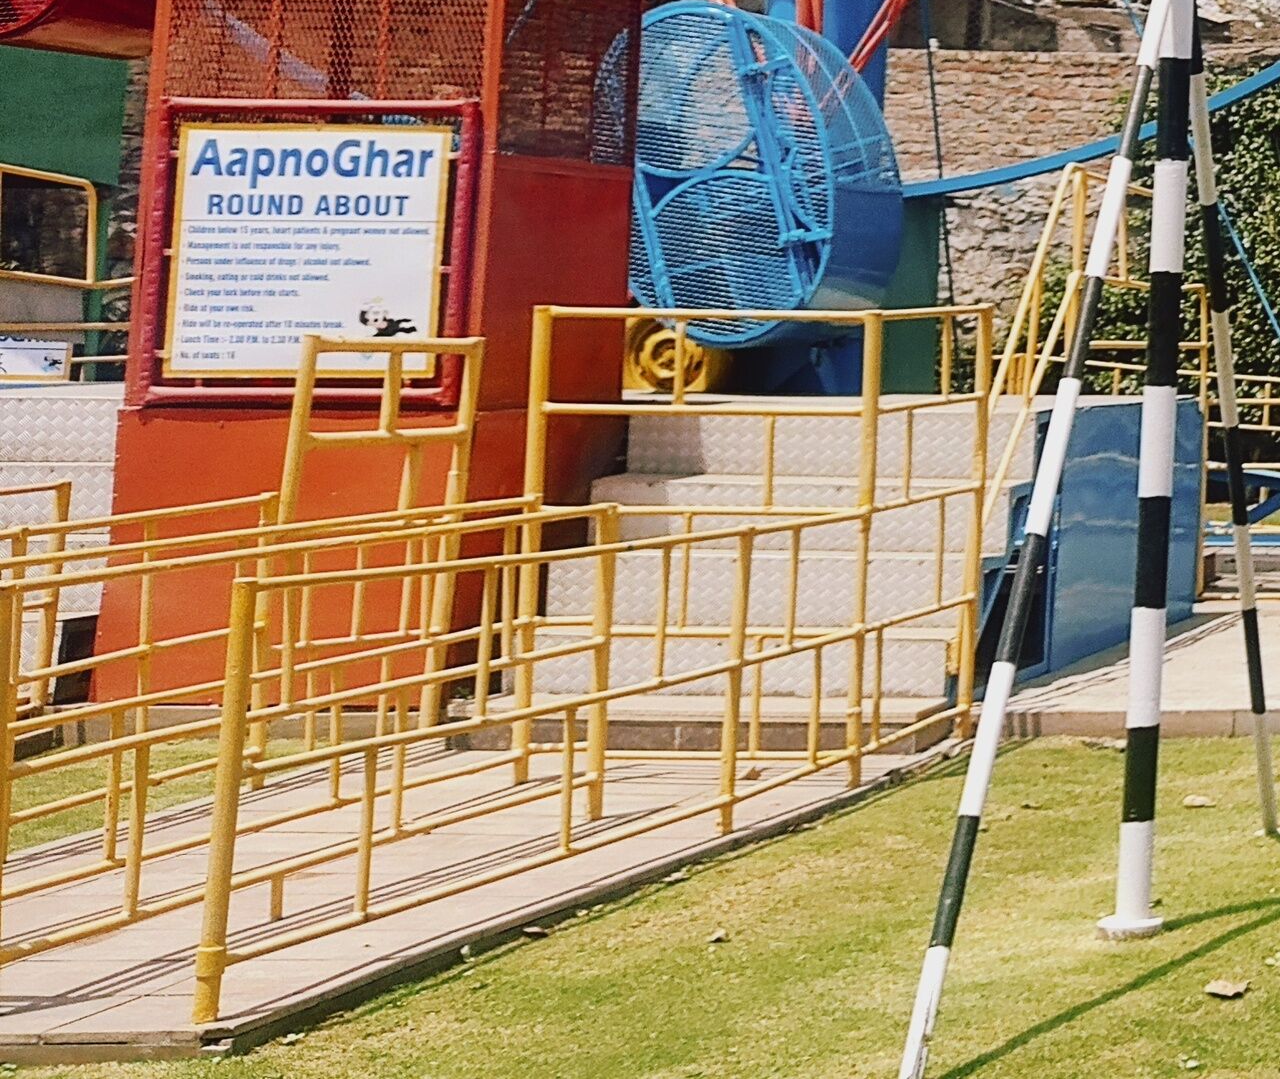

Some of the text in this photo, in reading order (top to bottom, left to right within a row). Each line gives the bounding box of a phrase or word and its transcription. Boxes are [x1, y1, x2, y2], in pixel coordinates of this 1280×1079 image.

[190, 138, 434, 189] AapnoGhar
[207, 194, 410, 217] ROUND ABOUT
